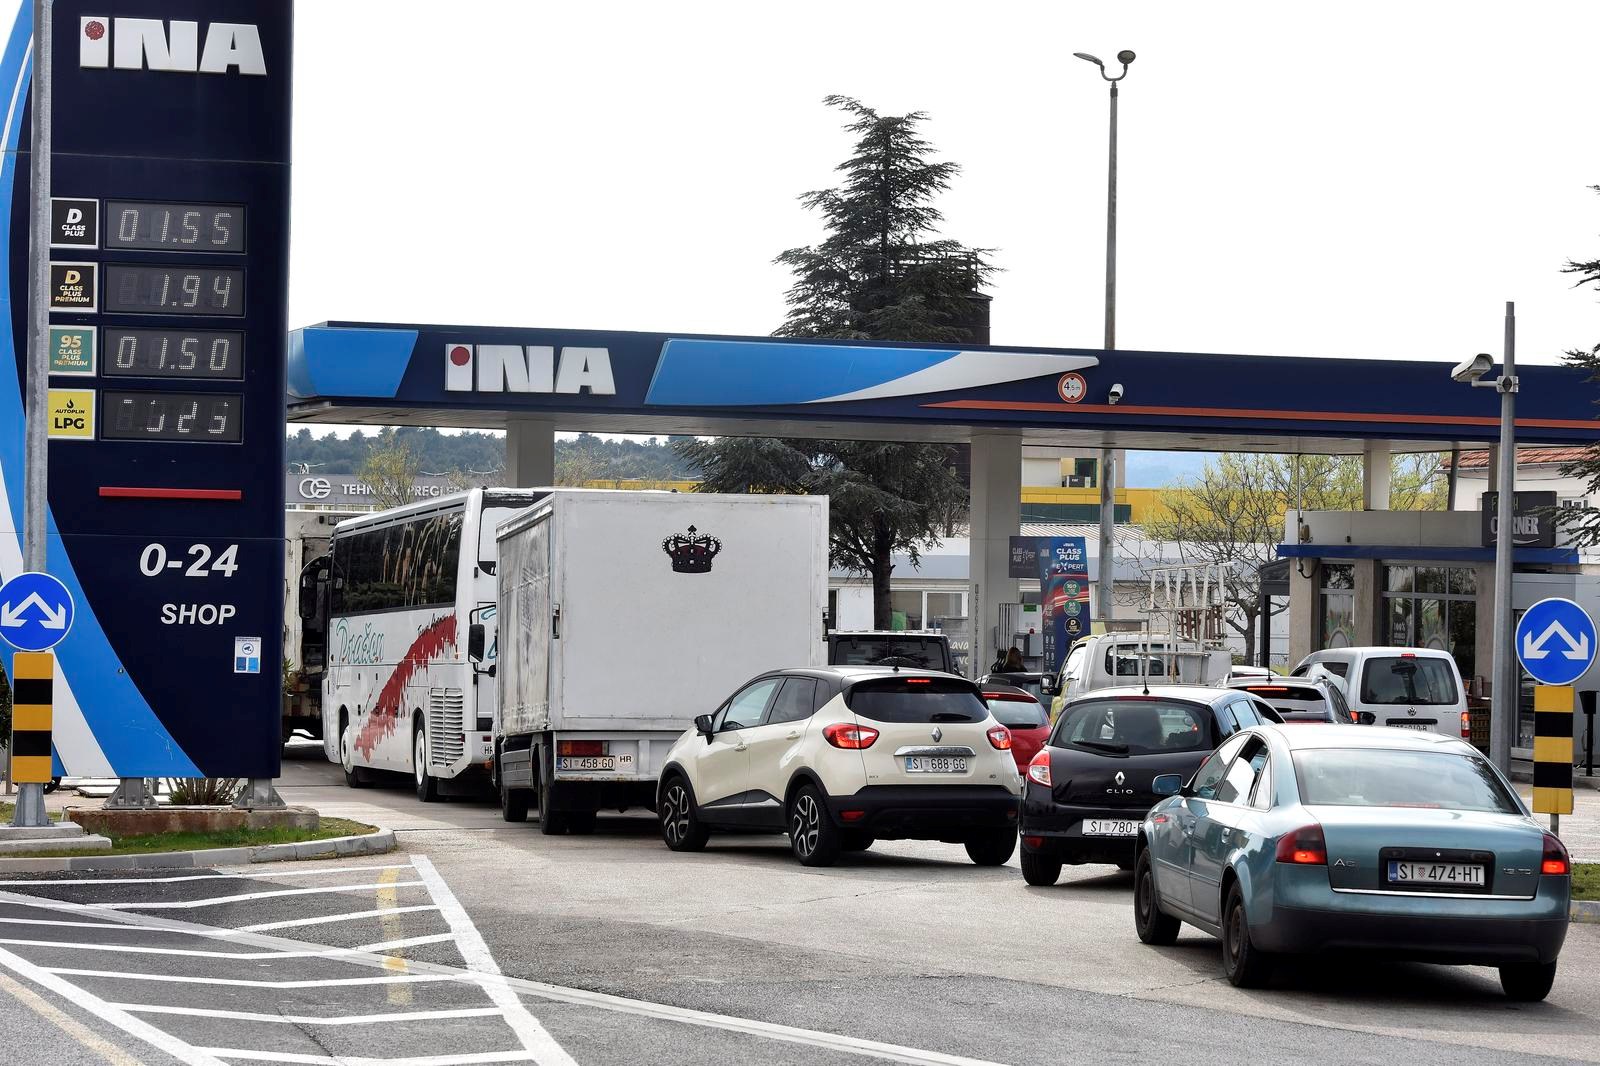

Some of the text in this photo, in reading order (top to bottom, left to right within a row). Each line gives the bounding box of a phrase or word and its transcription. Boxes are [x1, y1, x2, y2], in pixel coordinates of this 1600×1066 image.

[66, 208, 82, 224] D
[65, 270, 80, 284] D
[61, 335, 82, 348] 95
[54, 417, 85, 430] LPG
[139, 543, 239, 577] 0-24
[160, 603, 236, 625] SHOP
[619, 755, 632, 763] HR
[1428, 865, 1481, 882] 474-HT
